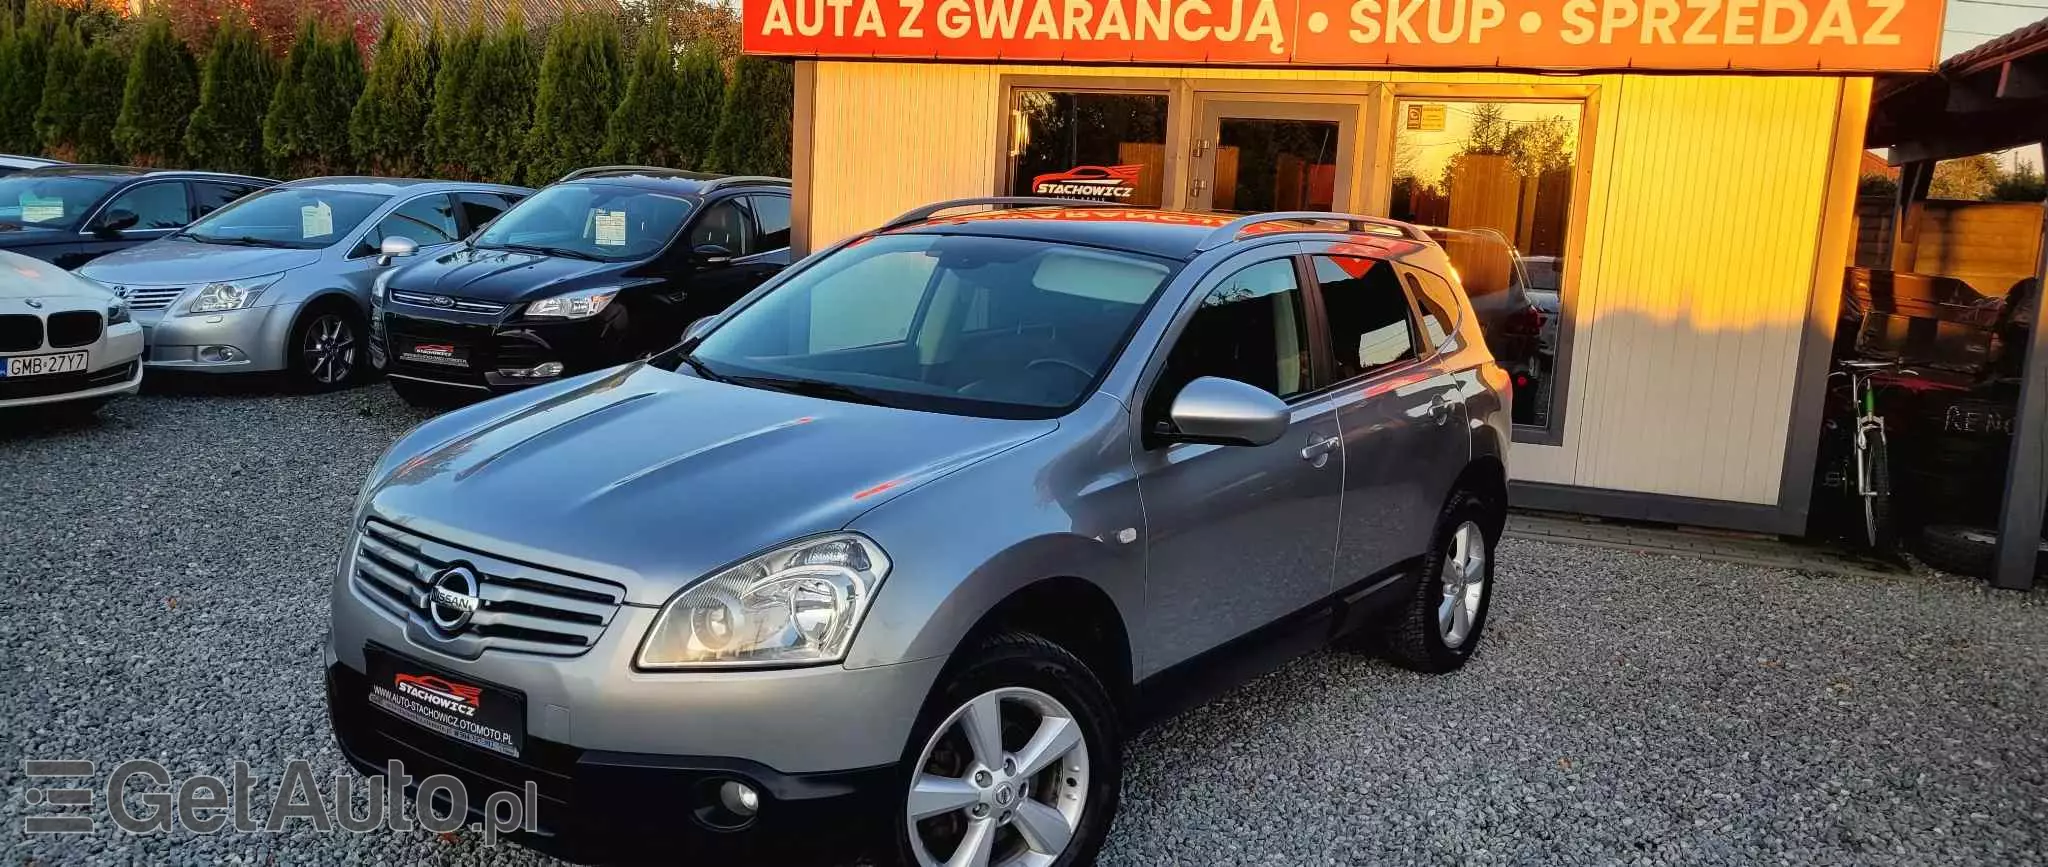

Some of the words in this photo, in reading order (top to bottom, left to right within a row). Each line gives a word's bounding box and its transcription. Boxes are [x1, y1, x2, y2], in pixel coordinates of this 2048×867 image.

[761, 0, 887, 37] AUTA
[898, 0, 924, 39] Z
[936, 0, 1285, 55] GWARANCJĄ
[1349, 0, 1505, 44] SKUP
[1037, 183, 1134, 198] STACHOWICZ
[11, 357, 42, 375] GMB
[48, 353, 84, 371] 27Y7
[373, 684, 513, 745] WWW.AUTO-STACHOWICZ.OTOMOTO.PL
[398, 682, 476, 716] STACHOWICZ
